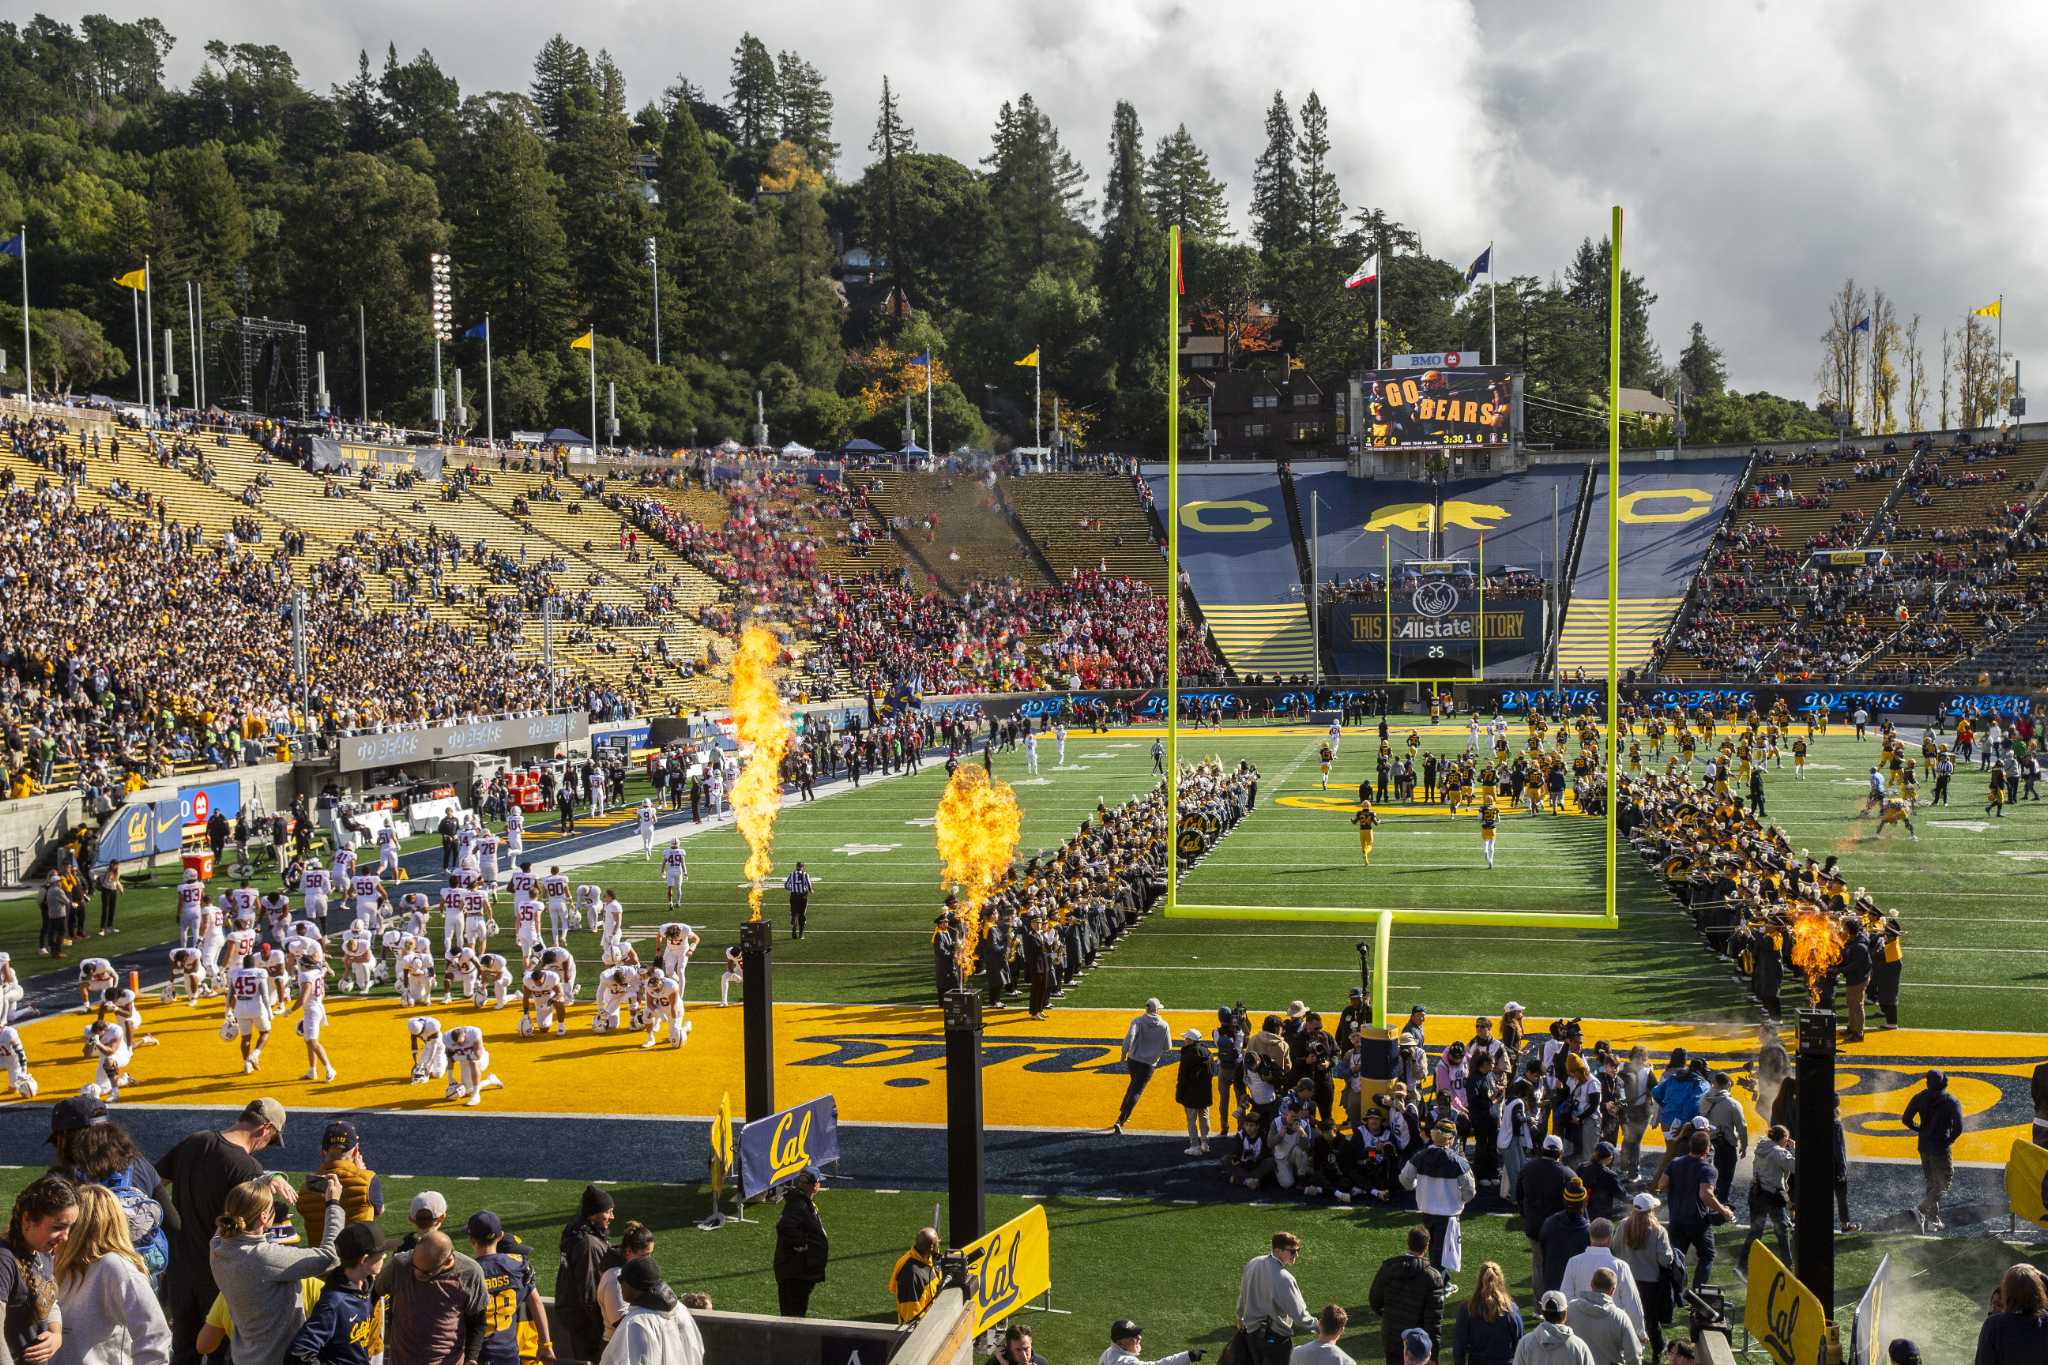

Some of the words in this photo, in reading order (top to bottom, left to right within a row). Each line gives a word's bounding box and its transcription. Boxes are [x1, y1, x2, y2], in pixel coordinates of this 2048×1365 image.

[1411, 356, 1441, 366] BMO
[1385, 380, 1419, 407] GO
[1420, 399, 1495, 425] BEARS
[1390, 436, 1397, 446] 0
[1443, 434, 1464, 444] 3:30
[1476, 433, 1483, 443] 0
[1618, 488, 1713, 524] C
[1179, 500, 1273, 533] C
[1351, 616, 1382, 638] THIS
[1399, 618, 1472, 639] Allstate
[1428, 646, 1445, 658] 25
[643, 811, 650, 822] 9
[128, 811, 148, 844] Cal
[481, 842, 497, 855] 78
[1179, 834, 1201, 852] Cal
[336, 852, 348, 865] 41
[667, 854, 682, 867] 49
[203, 860, 213, 873] G
[306, 875, 322, 888] 58
[356, 882, 374, 896] 59
[515, 877, 531, 891] 72
[183, 888, 200, 903] 83
[547, 882, 564, 897] 80
[241, 894, 250, 909] 3
[445, 894, 461, 909] 46
[464, 896, 482, 911] 39
[520, 906, 533, 922] 35
[235, 976, 257, 995] 45
[769, 1109, 812, 1185] Cal
[979, 1229, 1021, 1328] Cal
[1764, 1270, 1800, 1365] Cal
